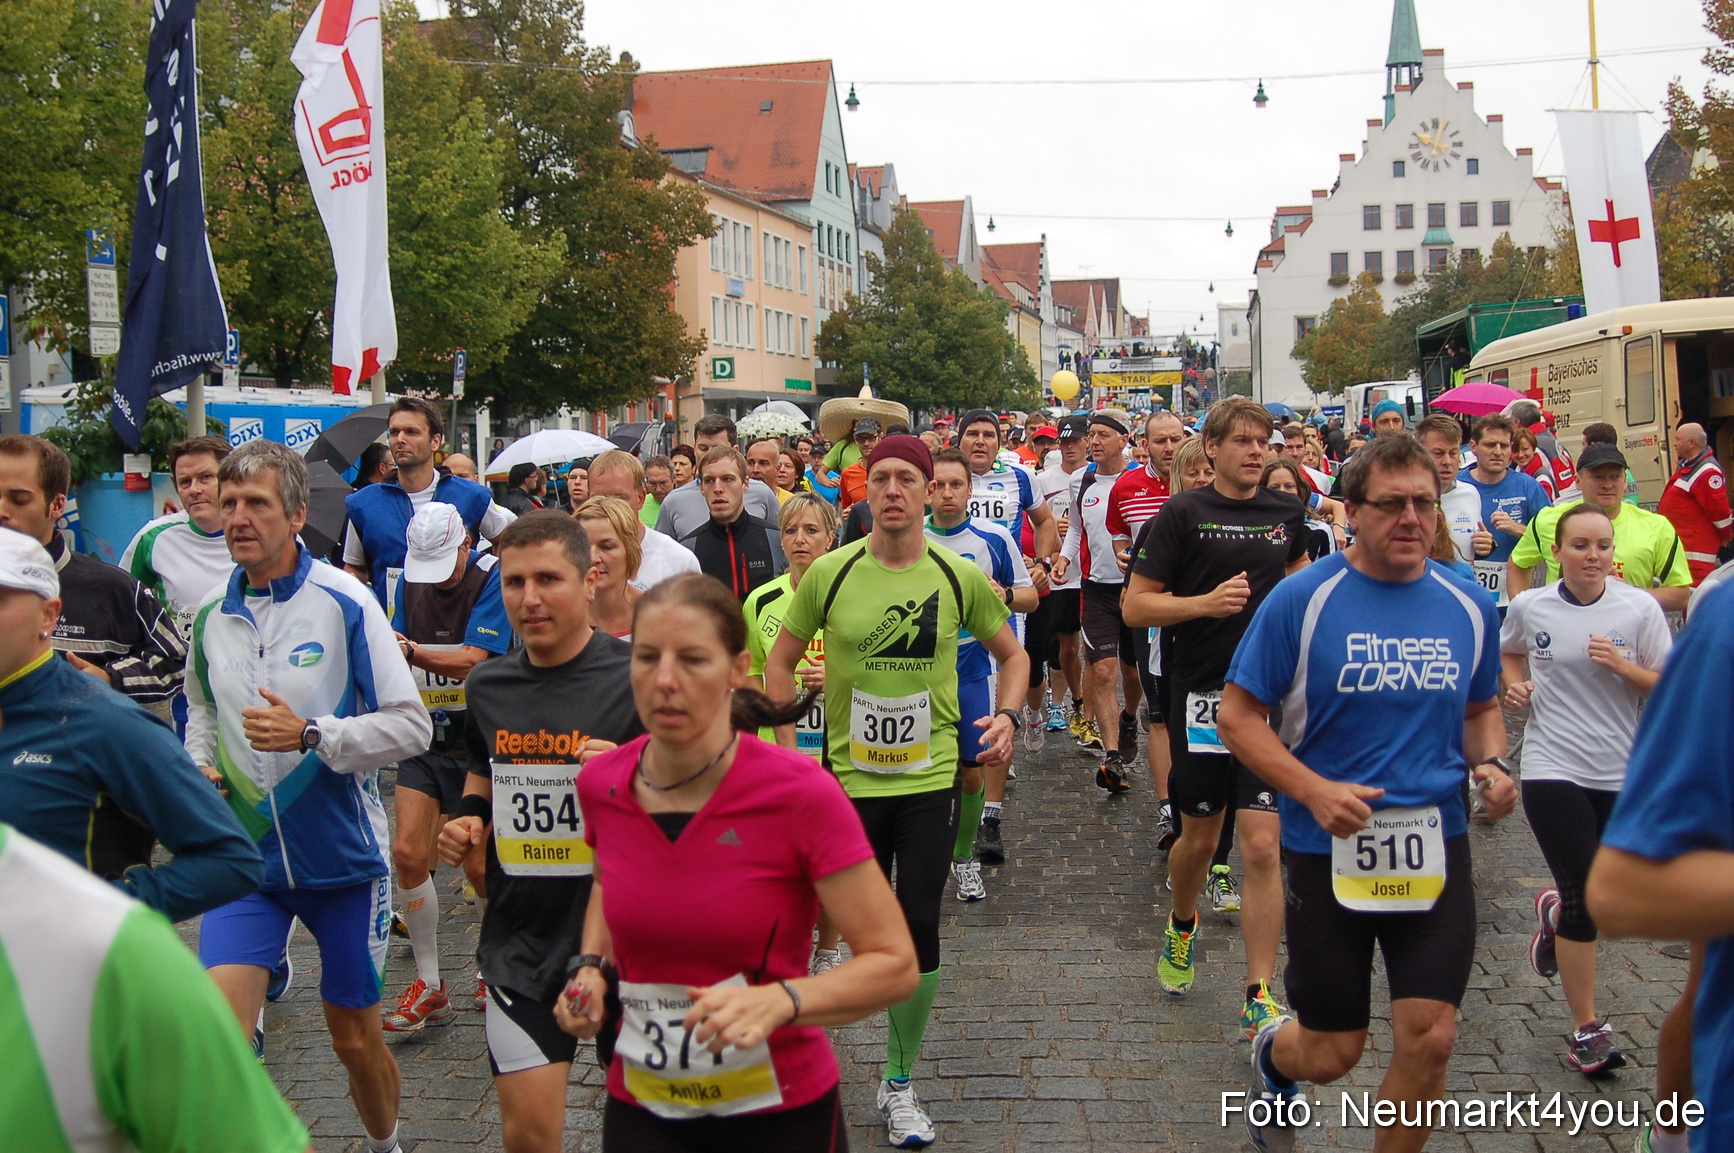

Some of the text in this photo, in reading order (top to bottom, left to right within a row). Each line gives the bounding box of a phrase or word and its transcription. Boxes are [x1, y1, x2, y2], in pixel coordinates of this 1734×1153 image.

[226, 333, 236, 361] P
[456, 354, 464, 375] P
[715, 360, 731, 376] D
[1548, 358, 1598, 386] Bayerisches
[1121, 375, 1152, 384] START
[1547, 387, 1571, 406] Rotes
[1200, 532, 1261, 540] Finisher
[857, 614, 898, 653] GOSSEN
[1346, 633, 1451, 661] Fitness
[865, 661, 935, 671] METRAWATT
[1337, 661, 1460, 693] CORNER
[429, 694, 459, 704] Lothar
[853, 697, 917, 713] PARTL Neumarkt
[863, 714, 915, 745] 302
[495, 729, 591, 756] Reebok
[867, 750, 909, 763] Markus
[494, 775, 577, 787] PARTL Neumarkt
[511, 792, 580, 833] 354
[1374, 819, 1424, 829] Neumarkt
[522, 844, 571, 860] Rainer
[1356, 833, 1424, 871] 510
[1371, 881, 1410, 896] Josef
[620, 998, 654, 1011] PARTL
[644, 1019, 724, 1071] 37
[669, 1081, 722, 1100] Anika
